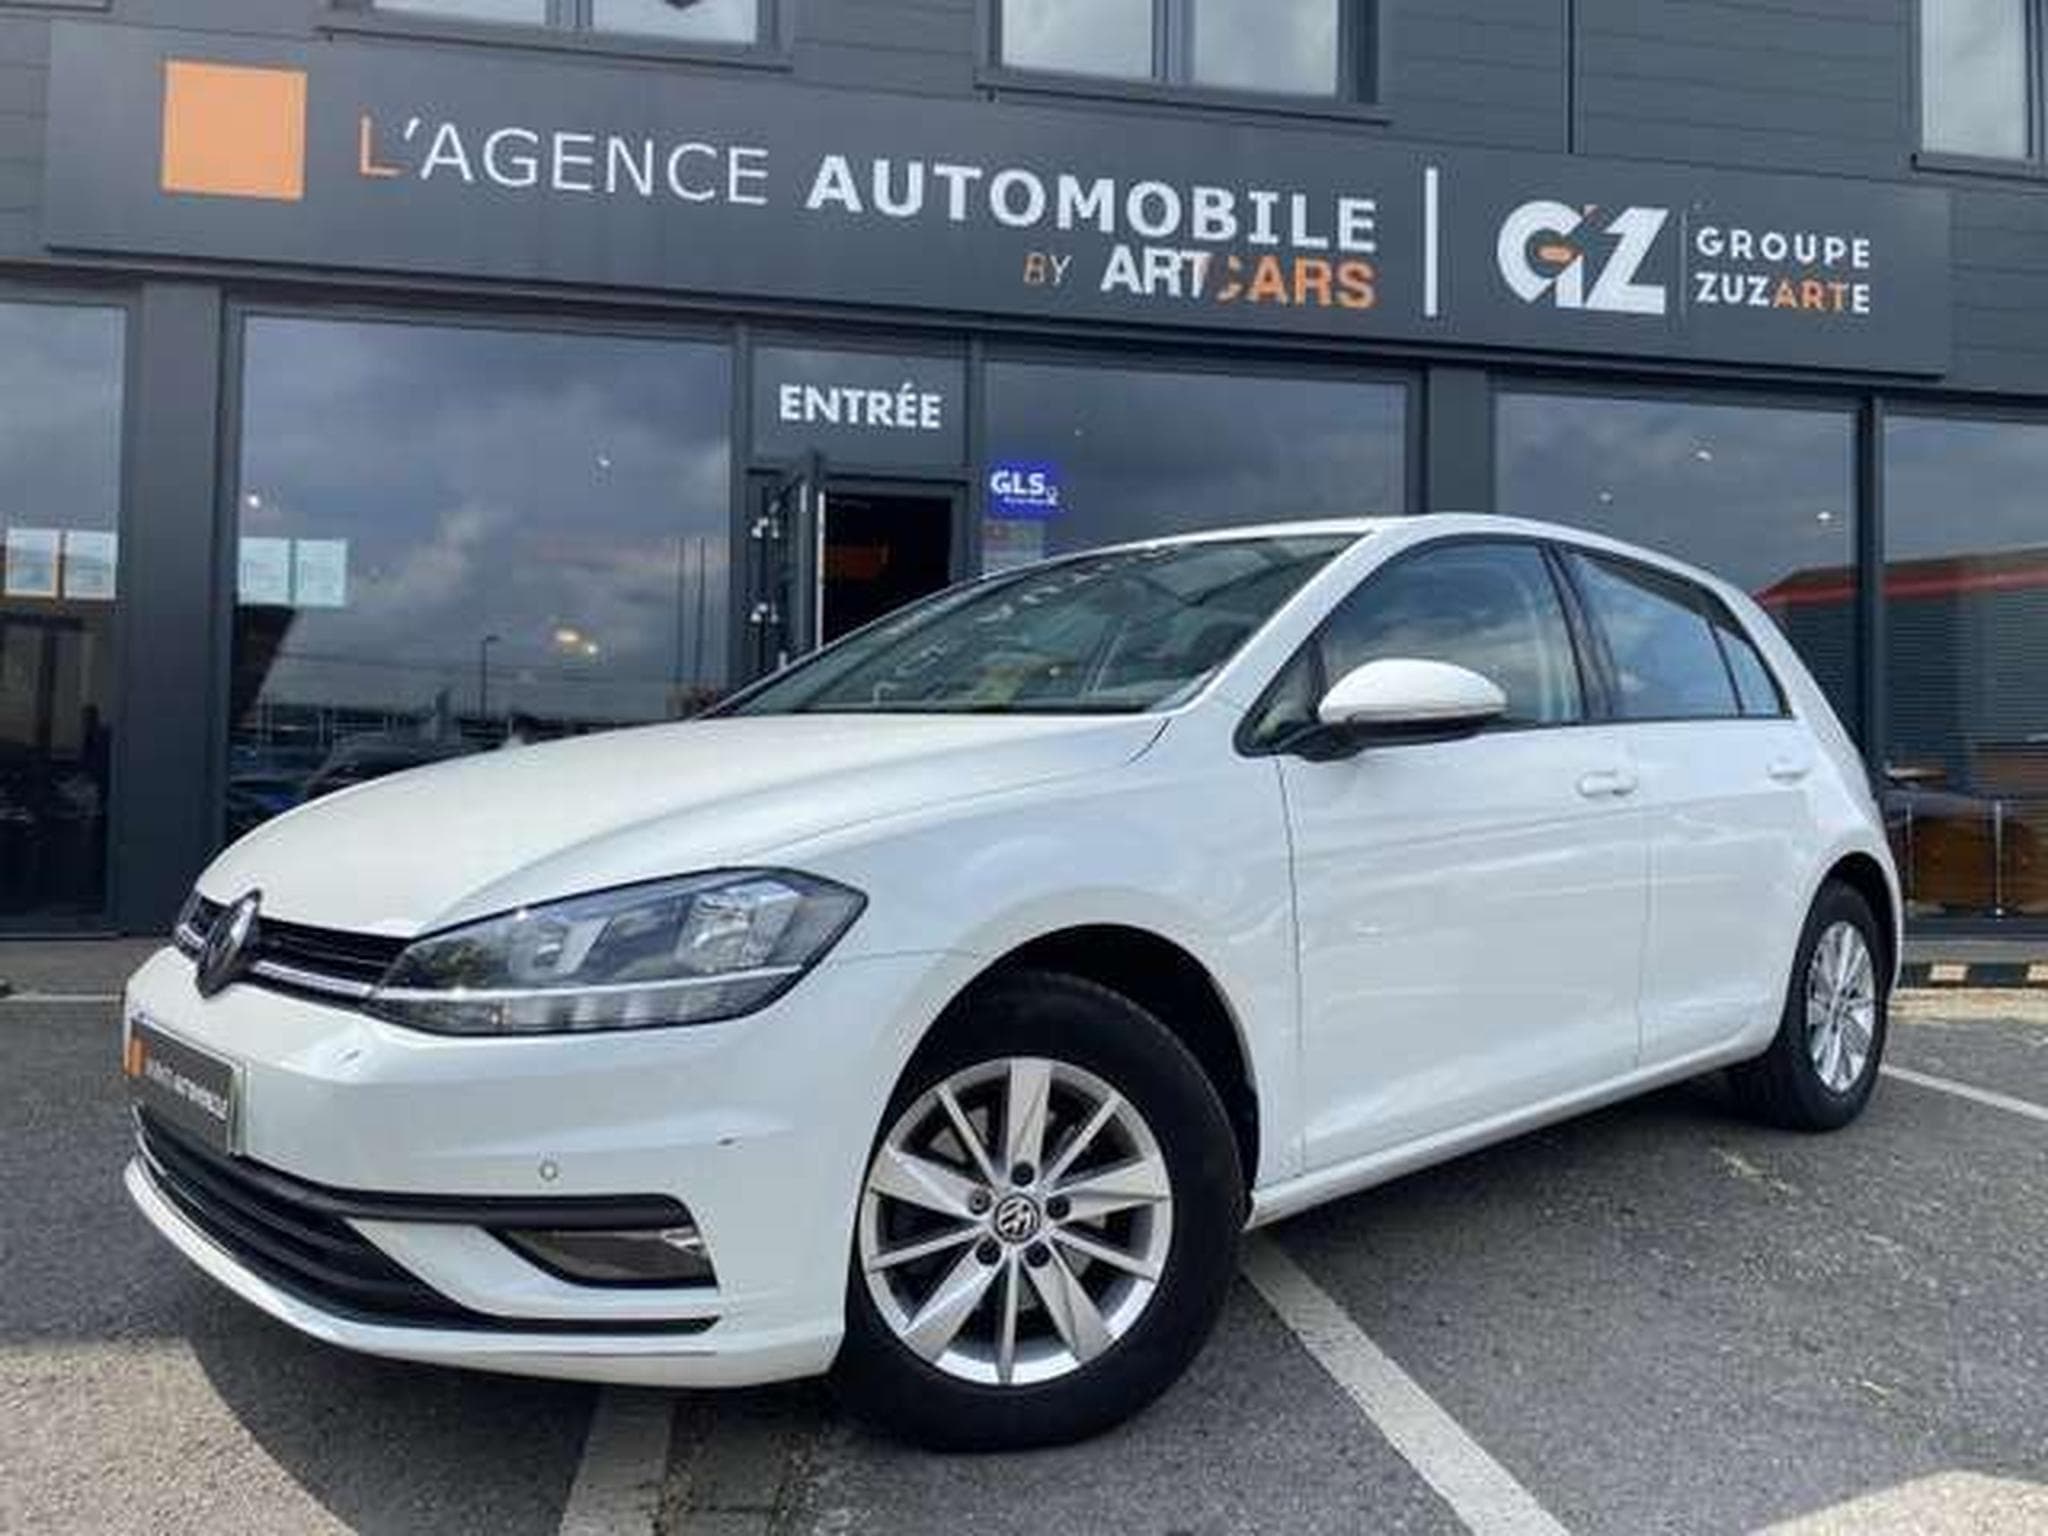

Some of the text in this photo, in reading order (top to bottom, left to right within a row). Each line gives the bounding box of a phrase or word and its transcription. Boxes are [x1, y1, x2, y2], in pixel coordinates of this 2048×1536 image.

[357, 114, 1378, 253] L'AGENCE AUTOMOBILE
[1696, 226, 1871, 269] GROUPE
[1023, 252, 1073, 287] BY
[1695, 273, 1871, 314] ZUZARTE
[779, 381, 943, 429] ENTRÉE
[990, 470, 1046, 496] GLS
